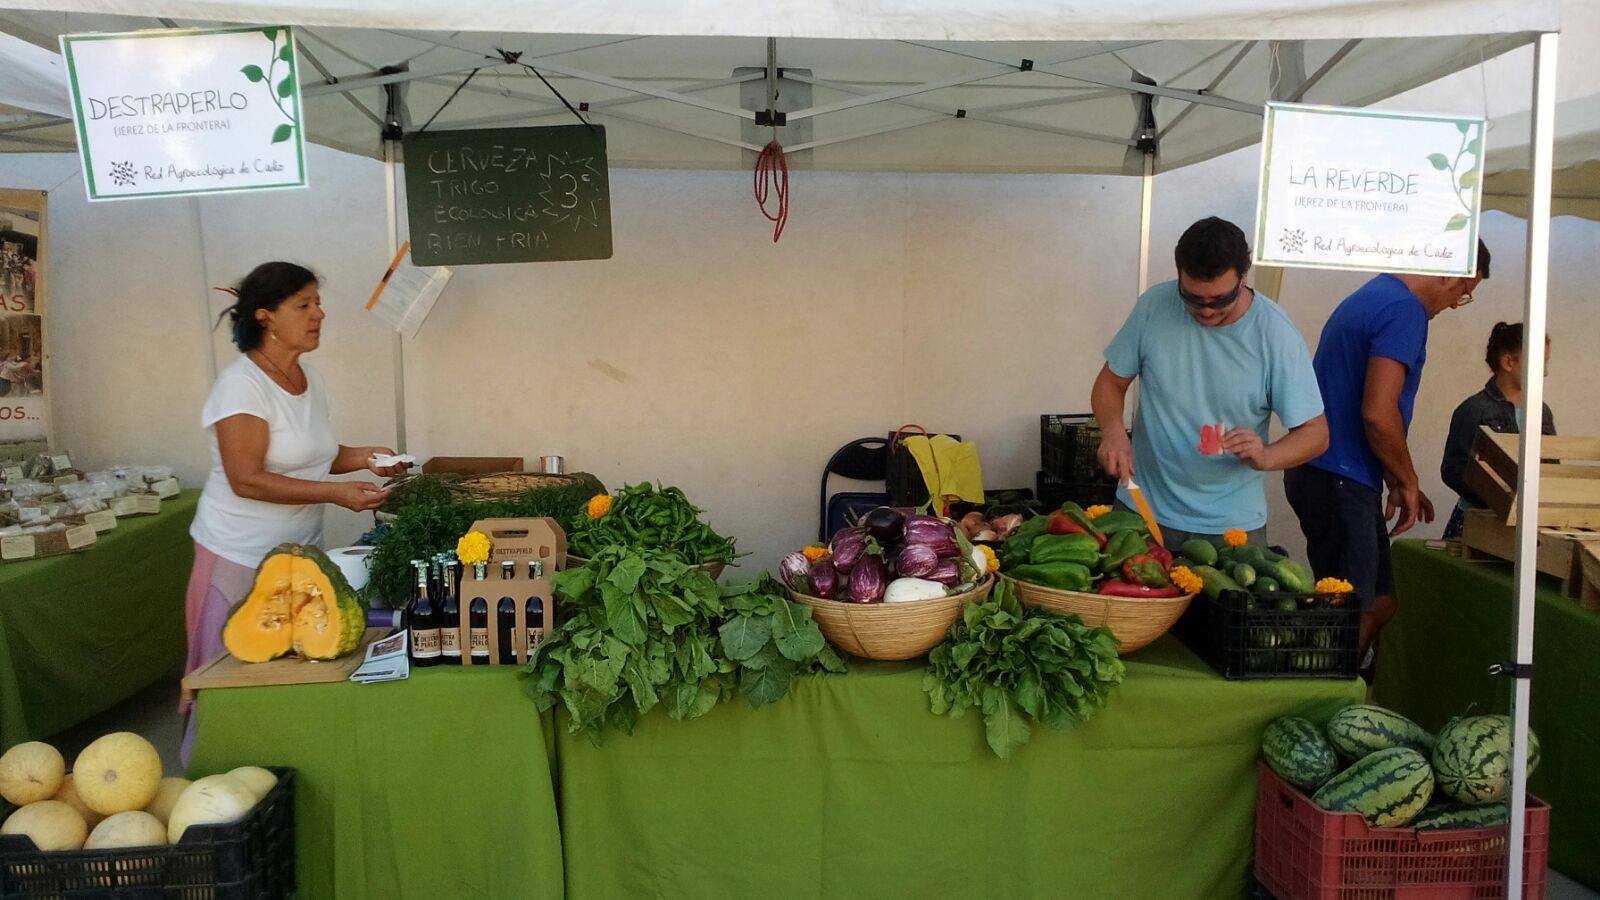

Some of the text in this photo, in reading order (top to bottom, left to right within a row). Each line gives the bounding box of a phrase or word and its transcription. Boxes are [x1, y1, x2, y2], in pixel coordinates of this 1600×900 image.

[88, 90, 248, 120] DESTRAPERLO
[147, 124, 160, 134] DE
[161, 122, 173, 133] LA
[428, 145, 538, 174] CERVEZA
[144, 165, 163, 180] Red
[240, 160, 250, 174] de
[1289, 165, 1420, 195] LA REVERDE
[430, 180, 500, 198] TRIGO
[1326, 198, 1340, 208] DE
[1341, 199, 1353, 210] LA
[427, 233, 481, 250] BIEN
[1313, 236, 1333, 251] Red
[1408, 243, 1419, 256] de
